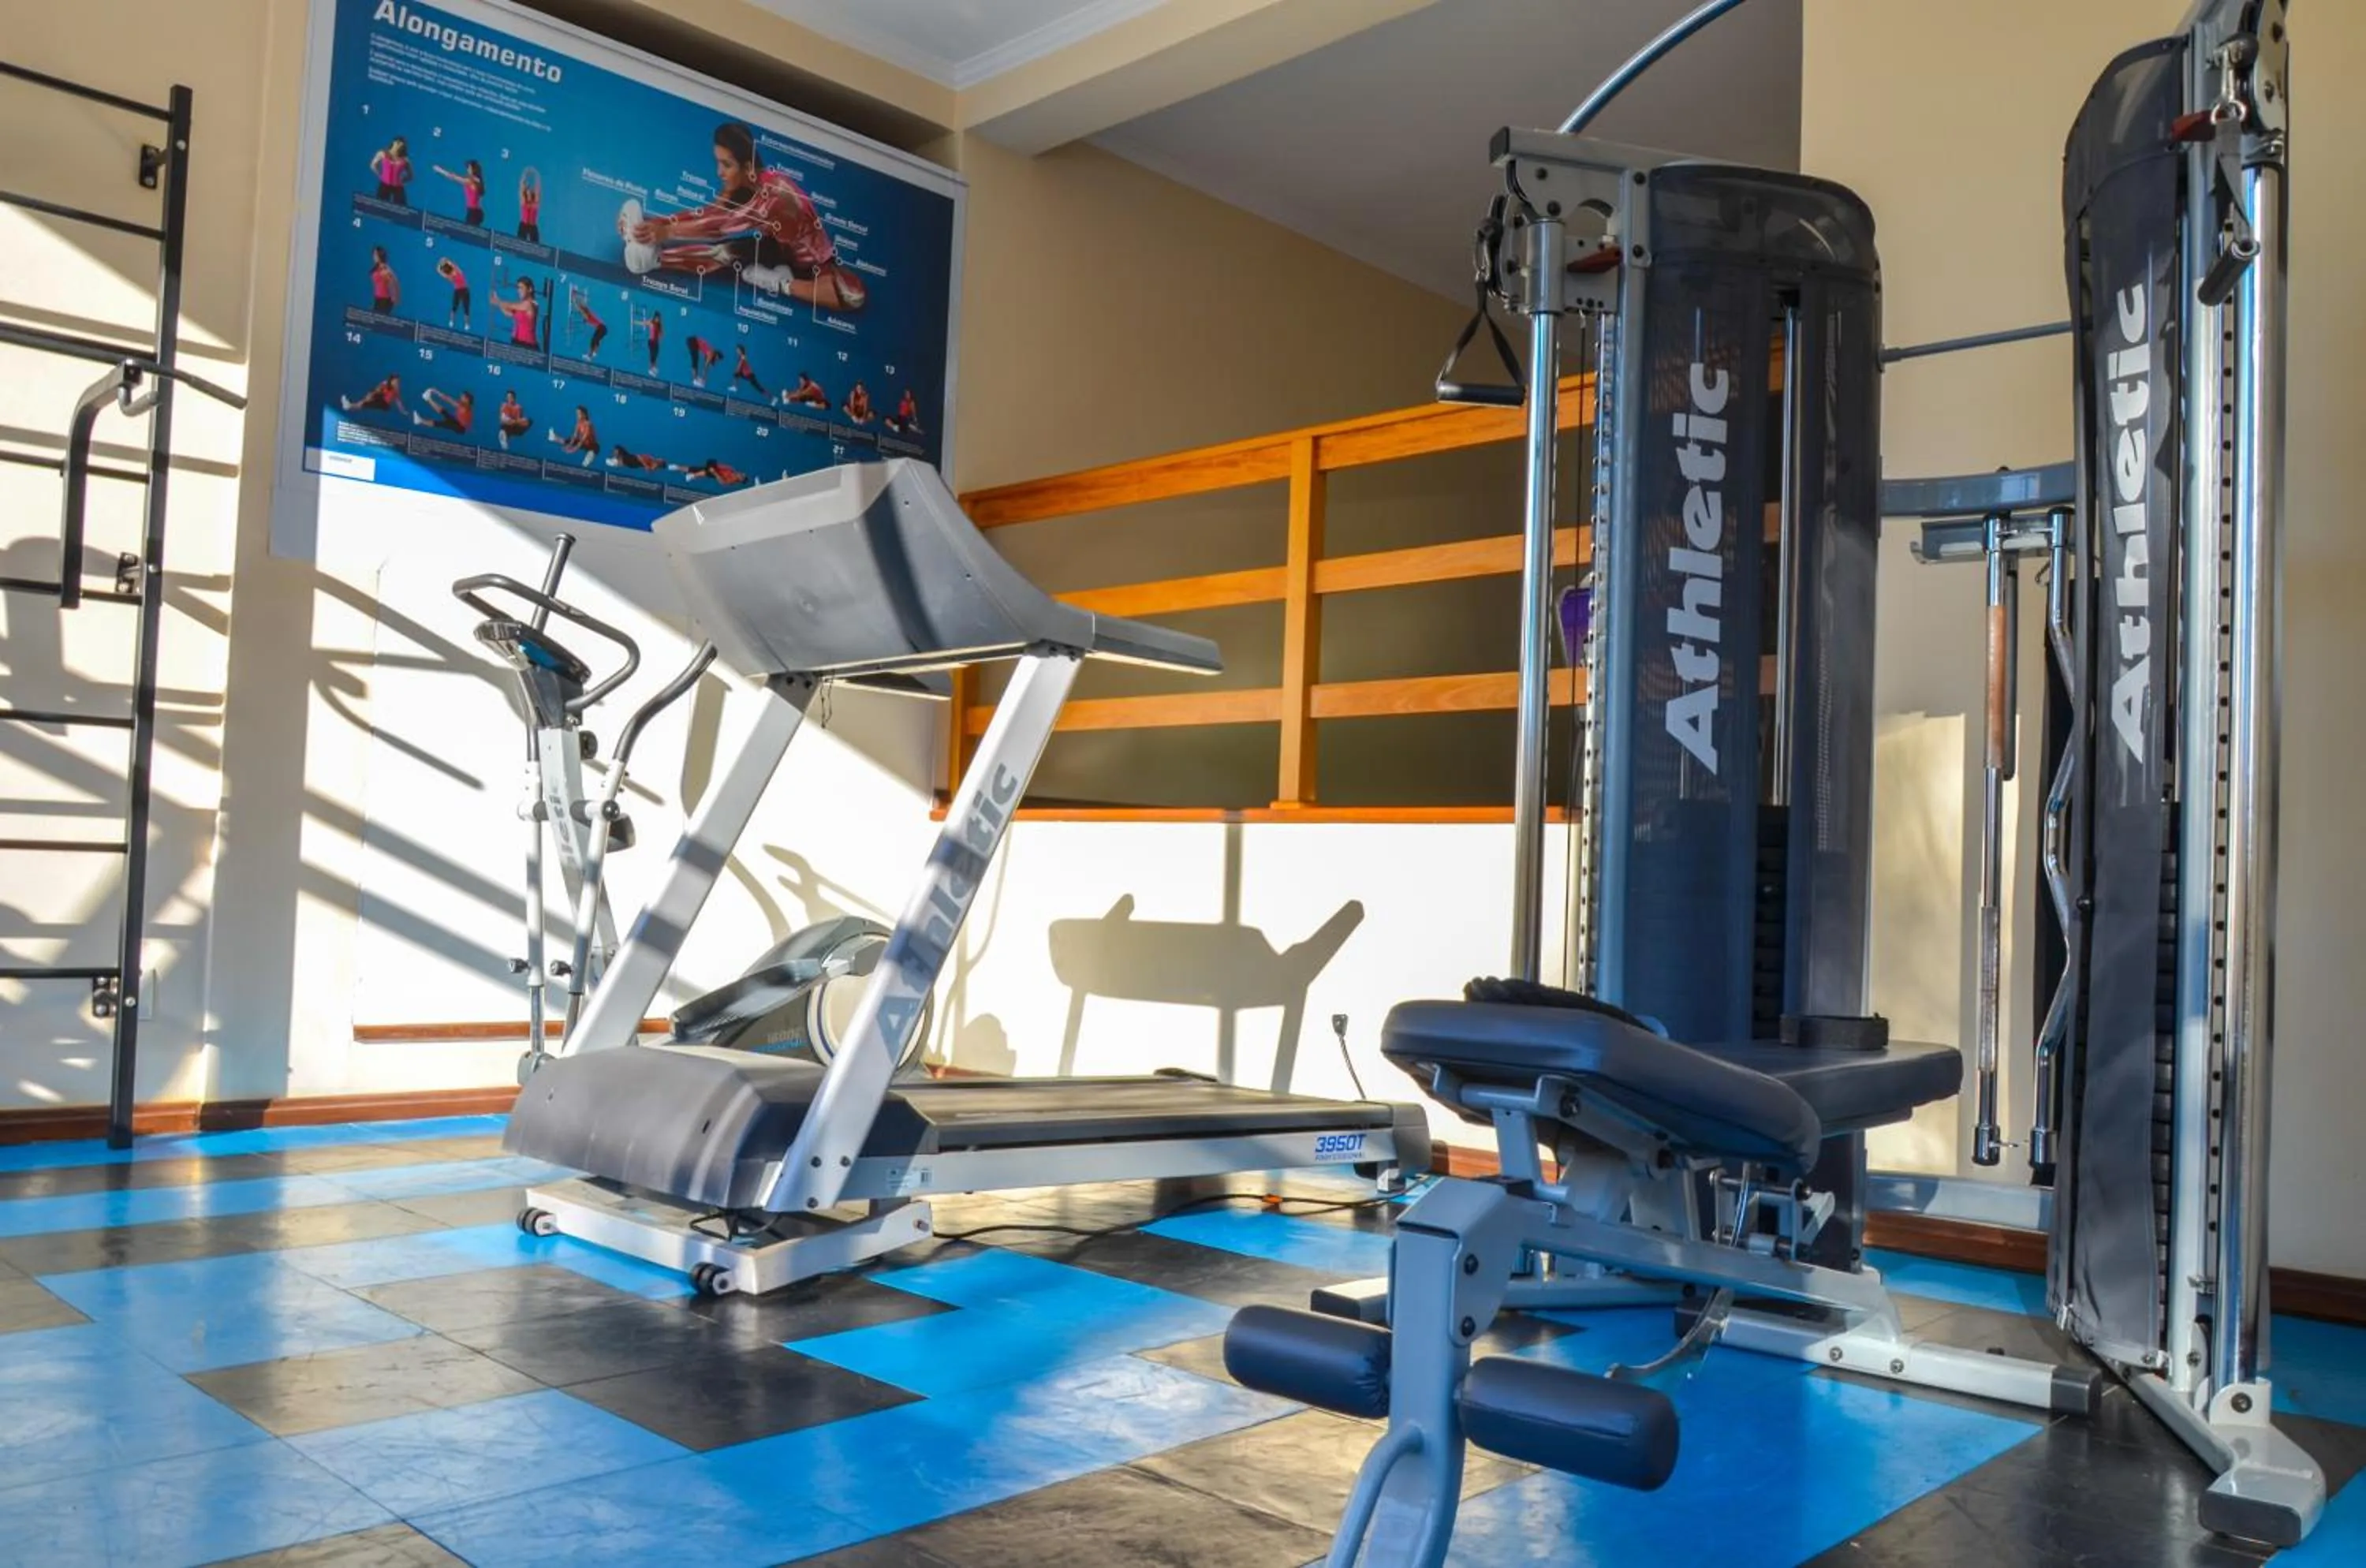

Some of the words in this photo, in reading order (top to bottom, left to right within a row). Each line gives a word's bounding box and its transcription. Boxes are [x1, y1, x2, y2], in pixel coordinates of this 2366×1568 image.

[374, 0, 563, 84] Alongamento
[362, 104, 369, 114] 1
[433, 127, 442, 137] 2
[501, 148, 509, 159] 3
[353, 218, 361, 228] 4
[559, 272, 567, 283] 7
[737, 323, 749, 334] 10
[346, 331, 361, 344] 14
[788, 337, 798, 347] 11
[419, 348, 433, 360] 15
[837, 351, 848, 361] 12
[487, 364, 501, 375] 16
[553, 379, 565, 390] 17
[673, 407, 685, 417] 19
[833, 445, 845, 455] 21
[2107, 282, 2151, 763] Athletic
[1665, 362, 1730, 775] Athletic
[1315, 1133, 1367, 1152] 3950T
